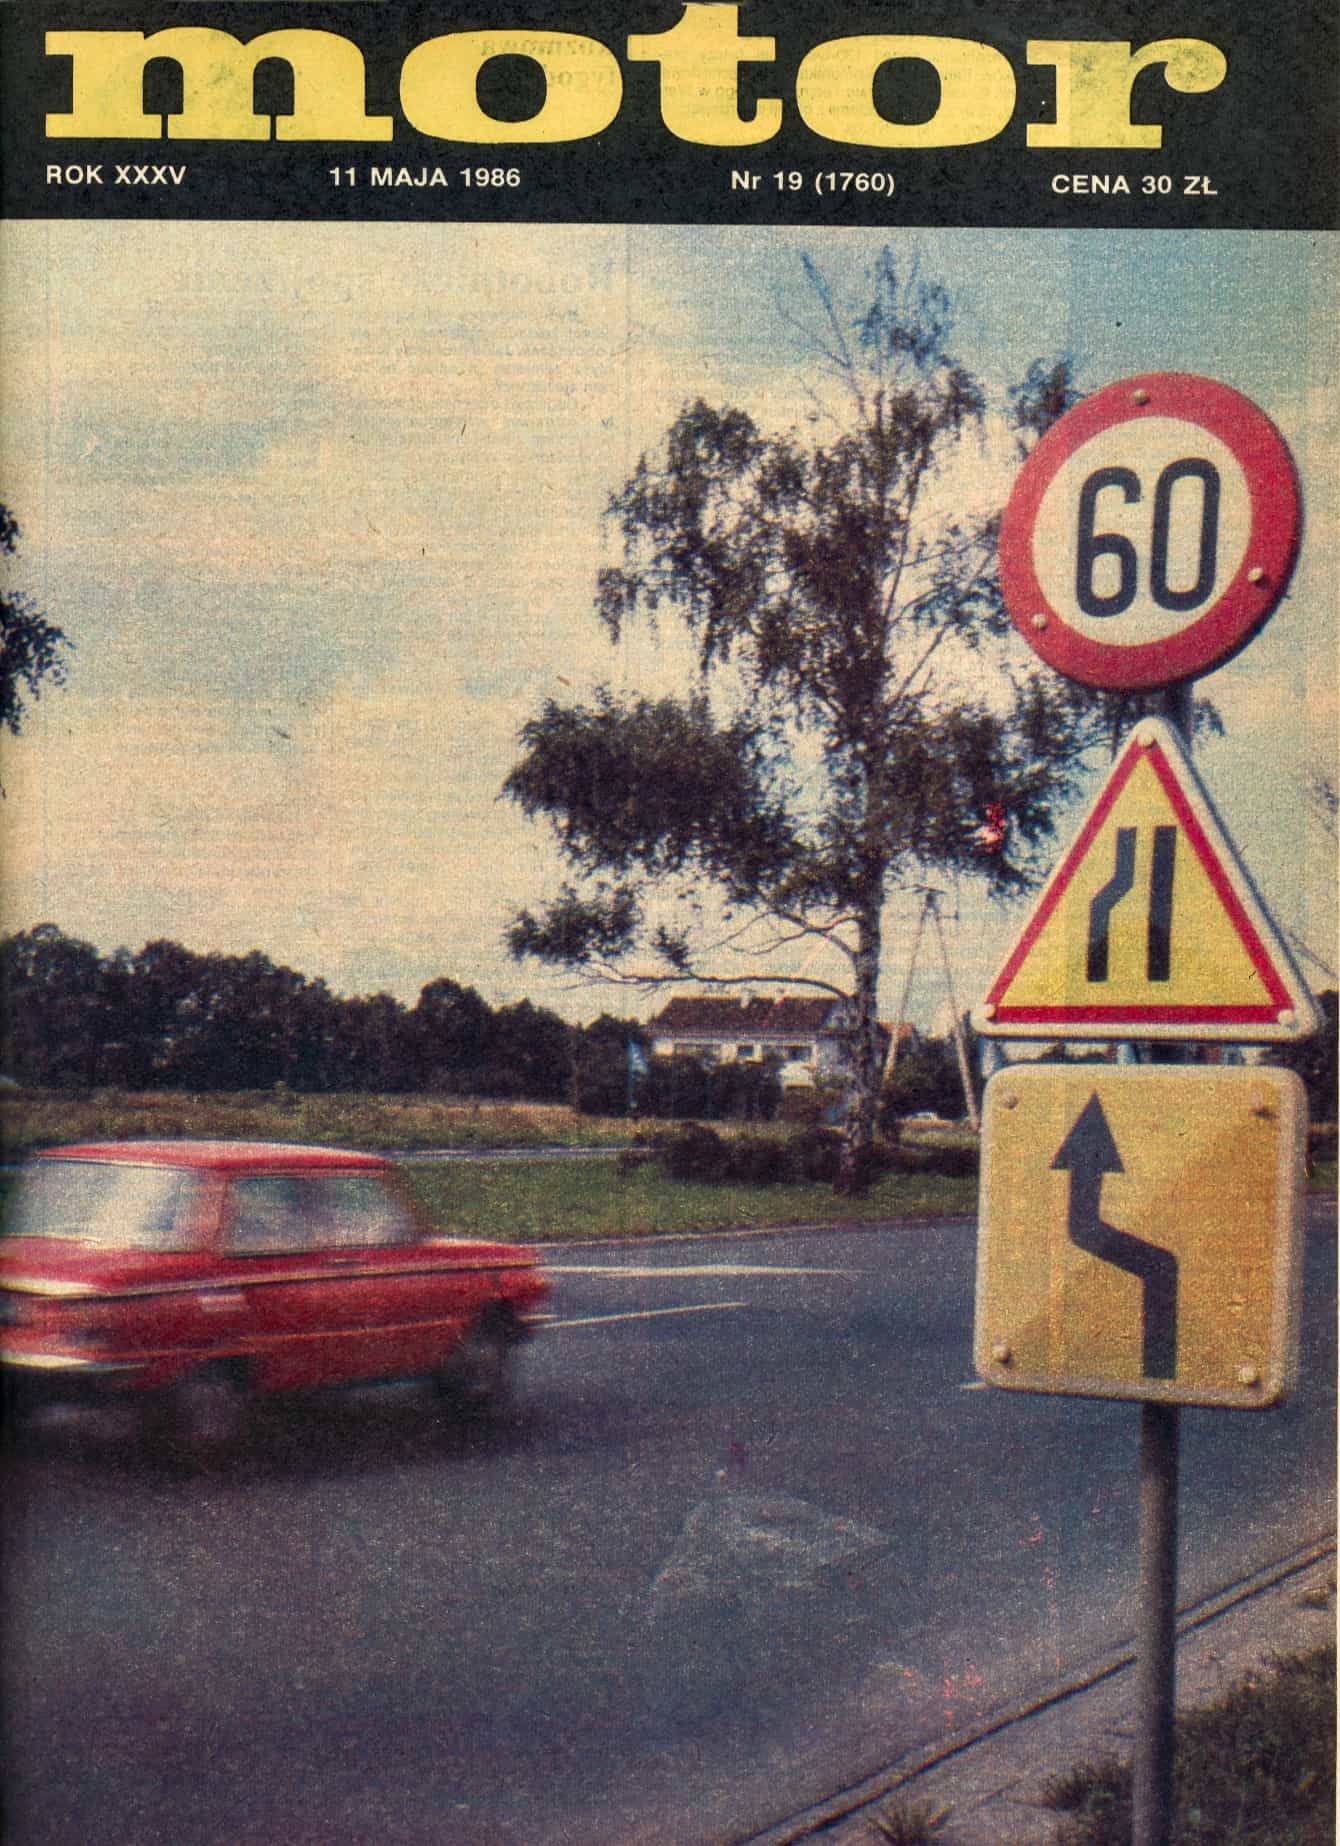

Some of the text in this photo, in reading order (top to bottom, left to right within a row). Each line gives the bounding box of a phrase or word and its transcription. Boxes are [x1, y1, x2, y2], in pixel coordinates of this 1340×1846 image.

[45, 3, 1227, 149] motor
[46, 164, 187, 185] ROK XXXV
[329, 167, 521, 188] 11 MAJA 1986
[731, 170, 895, 197] Nr 19 (1760)
[1051, 174, 1218, 195] CENA 30 ZŁ
[1076, 457, 1220, 617] 60
